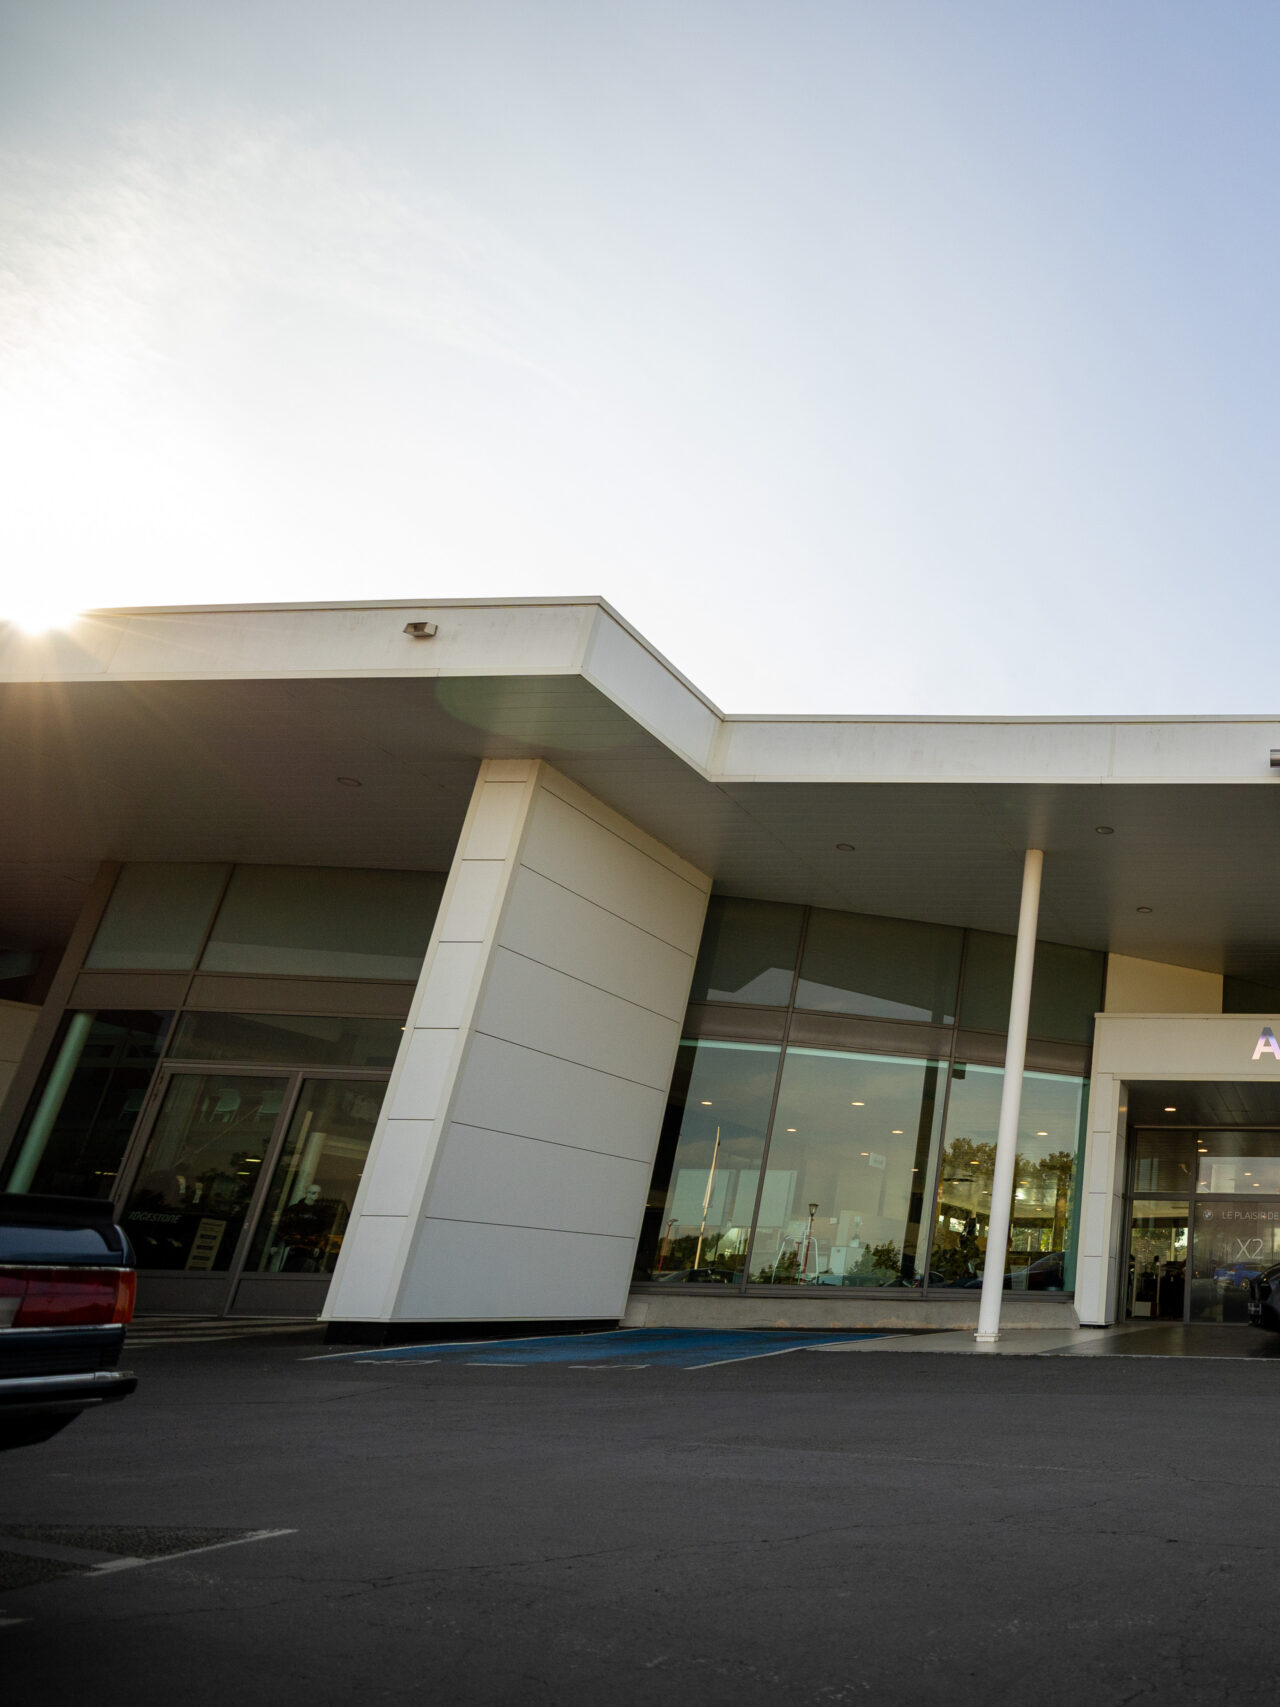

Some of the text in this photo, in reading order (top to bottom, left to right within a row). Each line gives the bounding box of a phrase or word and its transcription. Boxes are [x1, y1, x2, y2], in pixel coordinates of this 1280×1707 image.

[1222, 1211, 1233, 1220] LE
[1234, 1211, 1266, 1221] PLAISIR
[1267, 1211, 1279, 1221] DE
[1236, 1238, 1264, 1260] X2
